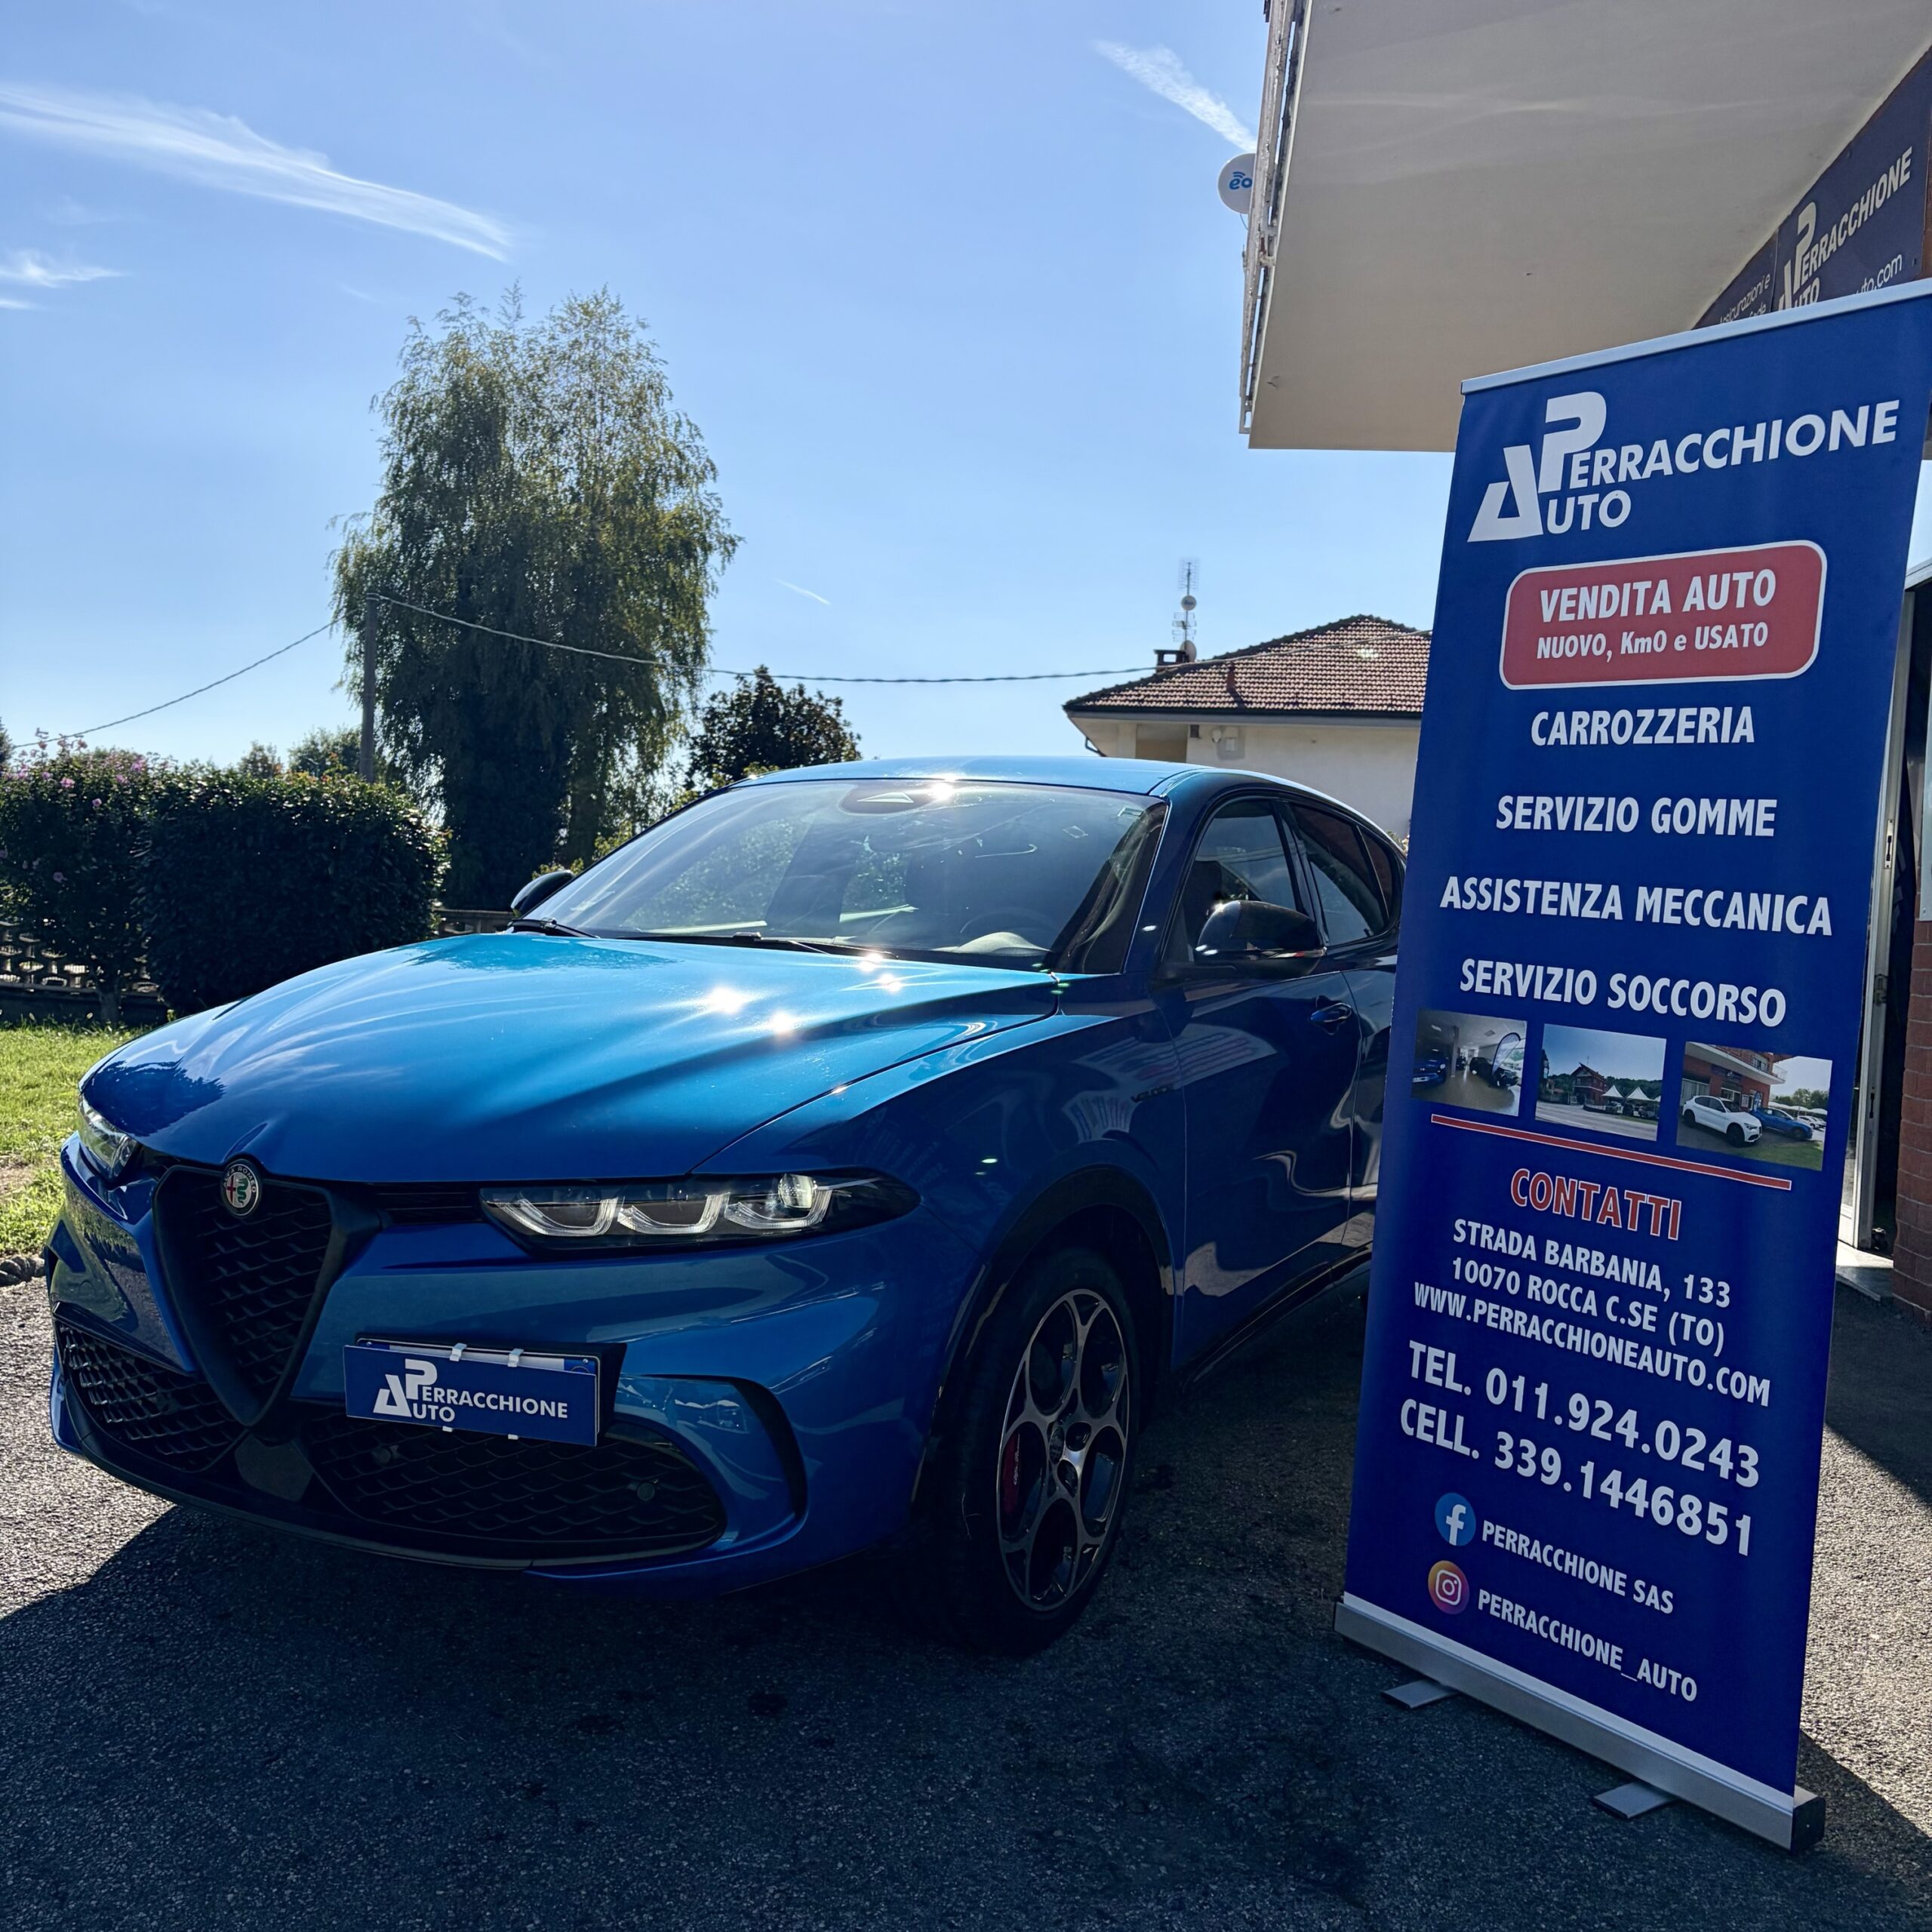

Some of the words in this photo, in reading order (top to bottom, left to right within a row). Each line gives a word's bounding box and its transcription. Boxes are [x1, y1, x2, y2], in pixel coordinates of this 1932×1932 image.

[1793, 146, 1912, 294] PERRACCHIONE
[1538, 391, 1900, 494] PERRACCHIONE
[1467, 445, 1632, 543] AUTO
[1540, 579, 1671, 623] VENDITA
[1684, 569, 1776, 612] AUTO
[1537, 632, 1612, 663] NUOVO,
[1674, 635, 1687, 652] e
[1694, 622, 1768, 651] USATO
[1532, 706, 1754, 746] CARROZZERIA
[1497, 795, 1638, 832] SERVIZIO
[1651, 798, 1777, 836] GOMME
[1440, 877, 1623, 919] ASSISTENZA
[1636, 887, 1832, 935] MECCANICA
[1460, 958, 1596, 1004] SERVIZIO
[1607, 974, 1786, 1026] SOCCORSO
[1511, 1168, 1681, 1241] CONTATTI
[1454, 1220, 1536, 1260] STRADA
[1545, 1240, 1669, 1301] BARBANIA,
[1684, 1275, 1729, 1307] 133
[1454, 1258, 1520, 1294] 10070
[1527, 1275, 1597, 1316] ROCCA
[1607, 1297, 1657, 1331] C.SE
[1669, 1312, 1723, 1356] (TO)
[1415, 1282, 1770, 1406] WWW.PERRACCHIONEAUTO.COM
[373, 1374, 455, 1423] AUTO
[405, 1358, 568, 1419] PERRACCHIONE
[1410, 1340, 1471, 1395] TEL.
[1487, 1368, 1758, 1487] 011.924.0243
[1401, 1399, 1478, 1458] CELL.
[1495, 1432, 1750, 1555] 339.1446851
[1483, 1521, 1626, 1595] PERRACCHIONE
[1634, 1580, 1672, 1613] SAS
[1478, 1589, 1697, 1700] PERRACCHIONE_AUTO
